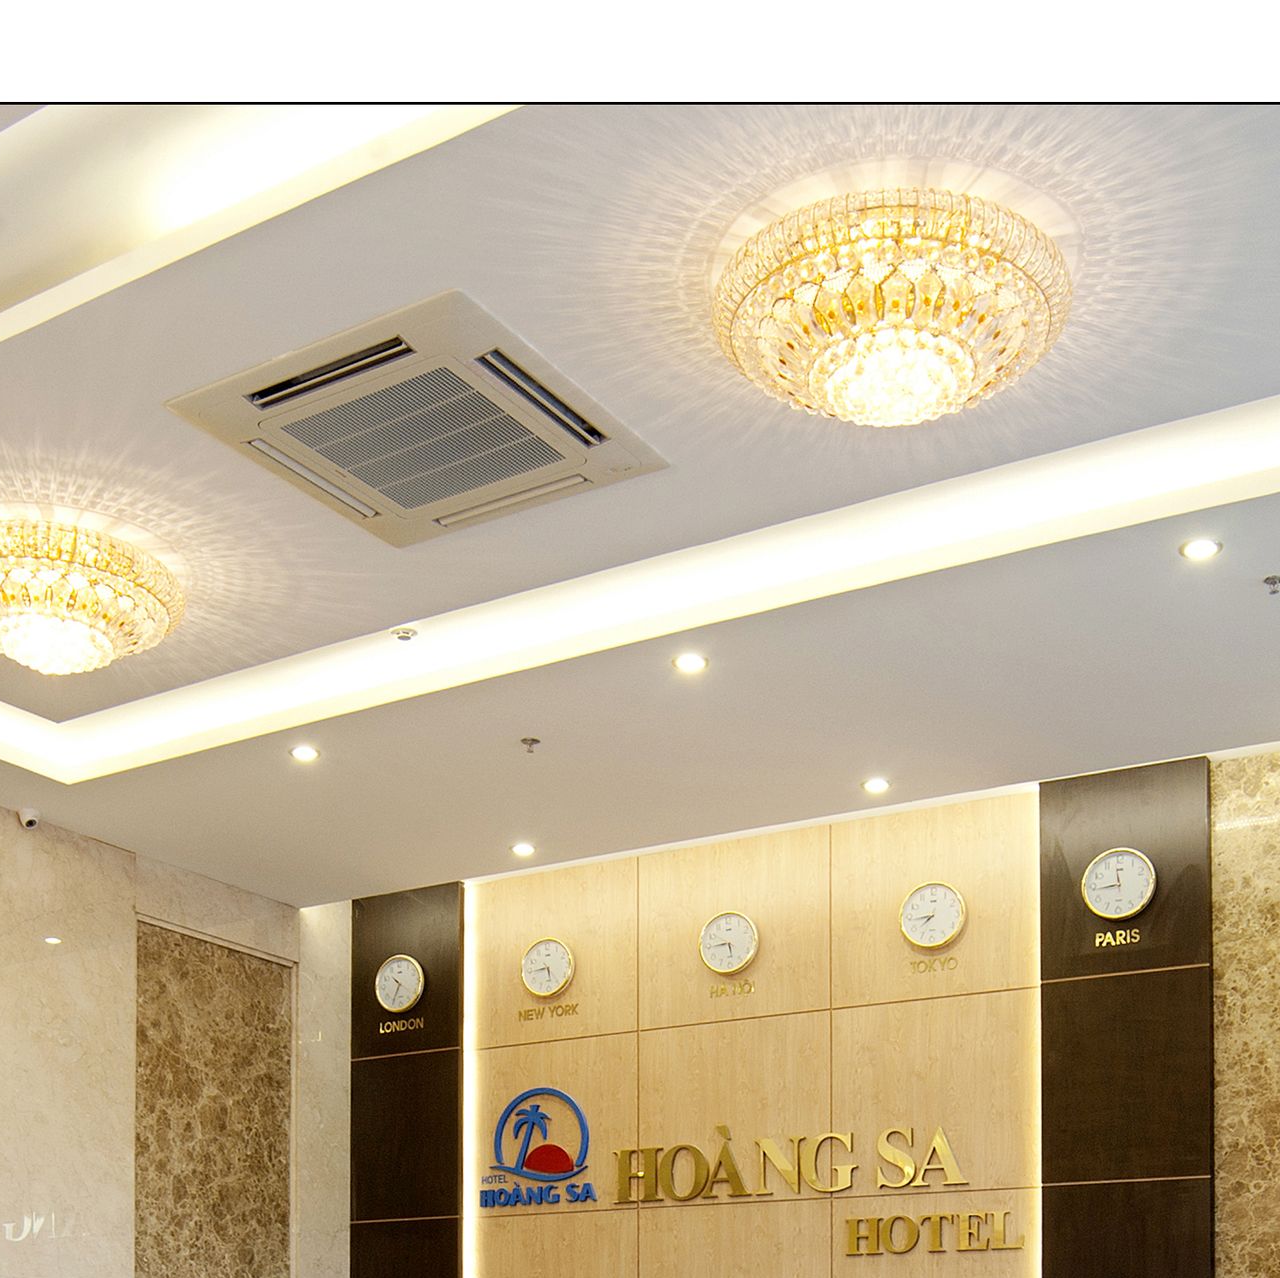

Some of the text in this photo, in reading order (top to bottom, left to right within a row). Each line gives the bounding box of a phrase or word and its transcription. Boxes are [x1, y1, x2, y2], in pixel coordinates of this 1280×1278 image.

[1095, 929, 1140, 947] PARIS
[910, 957, 958, 974] TOKYO
[518, 1003, 579, 1022] NEW YORK
[379, 1017, 424, 1034] LONDON
[612, 1124, 970, 1204] HOÀNG SA
[481, 1174, 508, 1184] HOTEL
[479, 1181, 598, 1207] HOÀNG SA
[845, 1210, 1026, 1258] HOTEL
